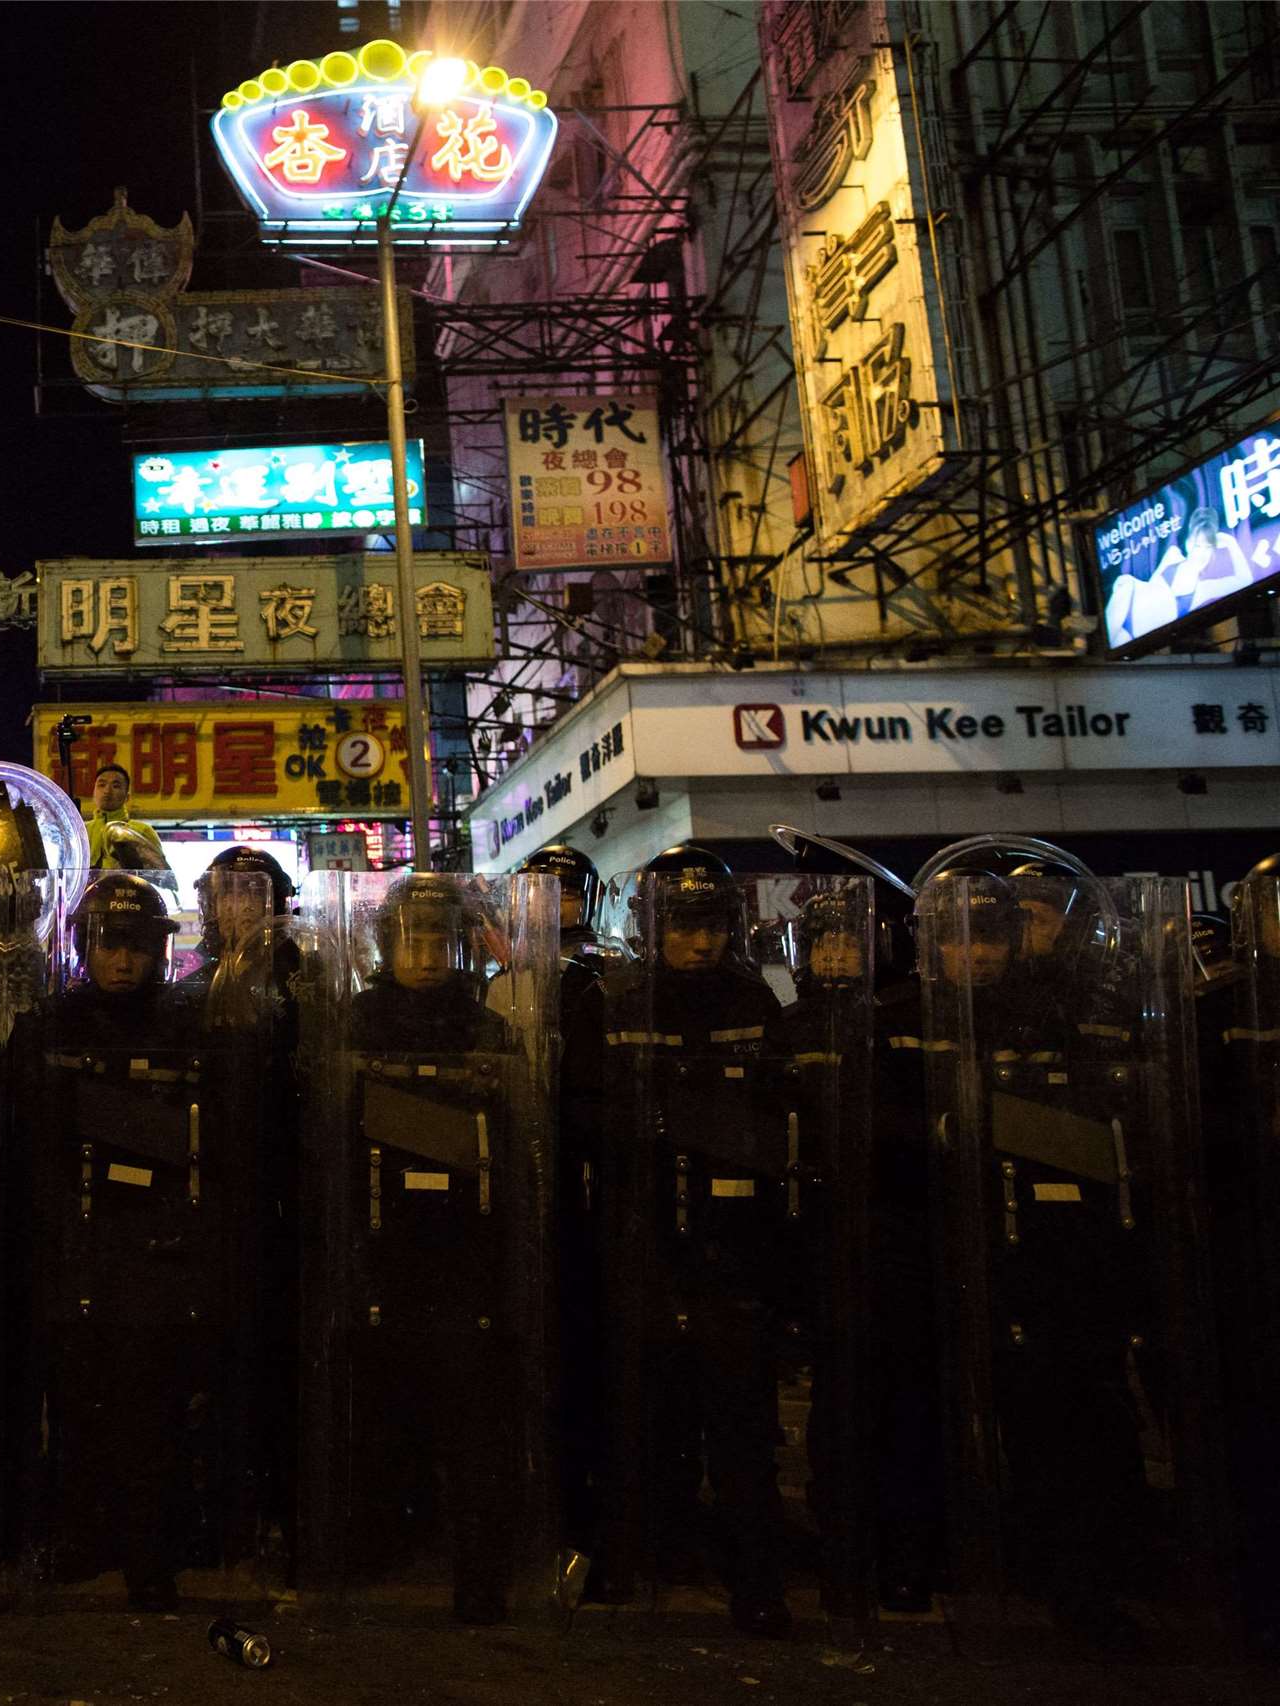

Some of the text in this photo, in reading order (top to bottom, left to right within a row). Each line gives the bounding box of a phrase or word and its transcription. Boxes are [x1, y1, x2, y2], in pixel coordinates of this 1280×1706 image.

[264, 109, 347, 183] 杏
[431, 106, 515, 183] 花
[519, 401, 647, 449] 時代
[542, 447, 629, 472] 夜總會
[586, 468, 642, 495] 98
[593, 499, 648, 525] 198
[140, 519, 181, 535] 時租
[1098, 503, 1165, 550] welcome
[1100, 516, 1182, 570] いらっしゃいませ
[801, 709, 910, 743] Kwun
[926, 707, 1005, 740] Kee
[1016, 705, 1131, 738] Tailor
[285, 754, 327, 779] OK
[549, 855, 577, 866] Police
[412, 889, 445, 899] Police
[680, 881, 716, 891] Police
[109, 901, 142, 911] Police
